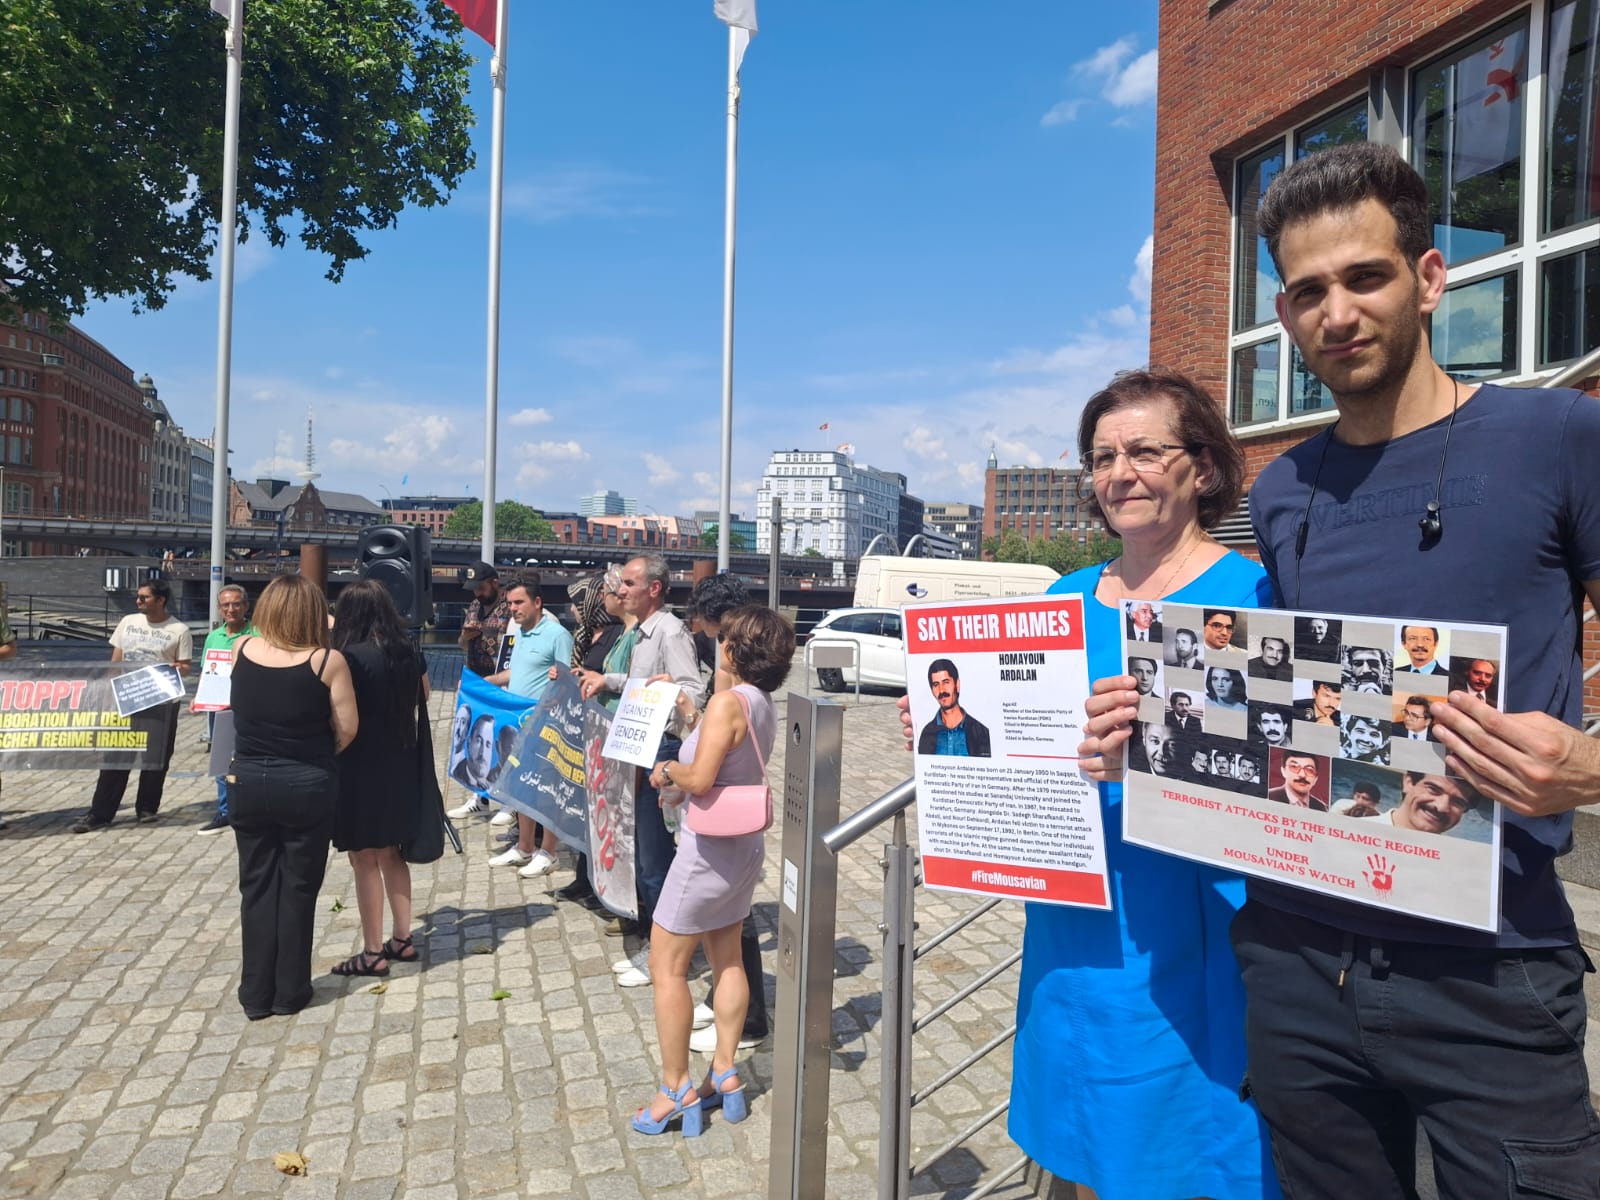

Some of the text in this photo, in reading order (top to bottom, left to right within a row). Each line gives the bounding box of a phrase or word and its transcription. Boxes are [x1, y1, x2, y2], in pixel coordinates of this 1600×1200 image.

[918, 610, 1070, 641] SAY THEIR NAMES
[999, 653, 1045, 665] HOMAYOUN
[1001, 669, 1037, 681] ARDALAN
[0, 680, 87, 710] TOPPT
[72, 712, 98, 727] MIT
[100, 712, 131, 727] DEM
[42, 731, 94, 747] REGIME
[96, 731, 148, 747] IRANS!!!
[615, 725, 647, 742] GENDER
[931, 763, 956, 772] Homayoun
[1014, 768, 1034, 776] January
[924, 779, 950, 787] Democratic
[952, 781, 964, 789] Party
[976, 775, 1012, 784] representative
[933, 796, 955, 804] Kurdistan
[956, 798, 983, 806] Democratic
[985, 800, 998, 808] Party
[1047, 805, 1073, 813] relocated
[1014, 794, 1041, 803] University
[1054, 797, 1070, 805] joined
[978, 808, 1002, 817] Alongside
[966, 824, 993, 834] September
[1162, 790, 1440, 860] TERRORIST ATTACKS BY THE ISLAMIC REGIME
[1264, 825, 1314, 843] OF IRAN
[982, 834, 998, 843] regime
[1000, 836, 1018, 845] gunned
[1064, 842, 1094, 850] individuals
[994, 853, 1020, 862] Homayoun
[1022, 855, 1042, 863] Ardalan
[1049, 849, 1072, 857] assailant
[1074, 851, 1092, 860] fatally
[1266, 848, 1309, 865] UNDER
[1224, 848, 1356, 889] MOUSAVIAN'S WATCH
[972, 870, 1047, 891] #FireMousavian
